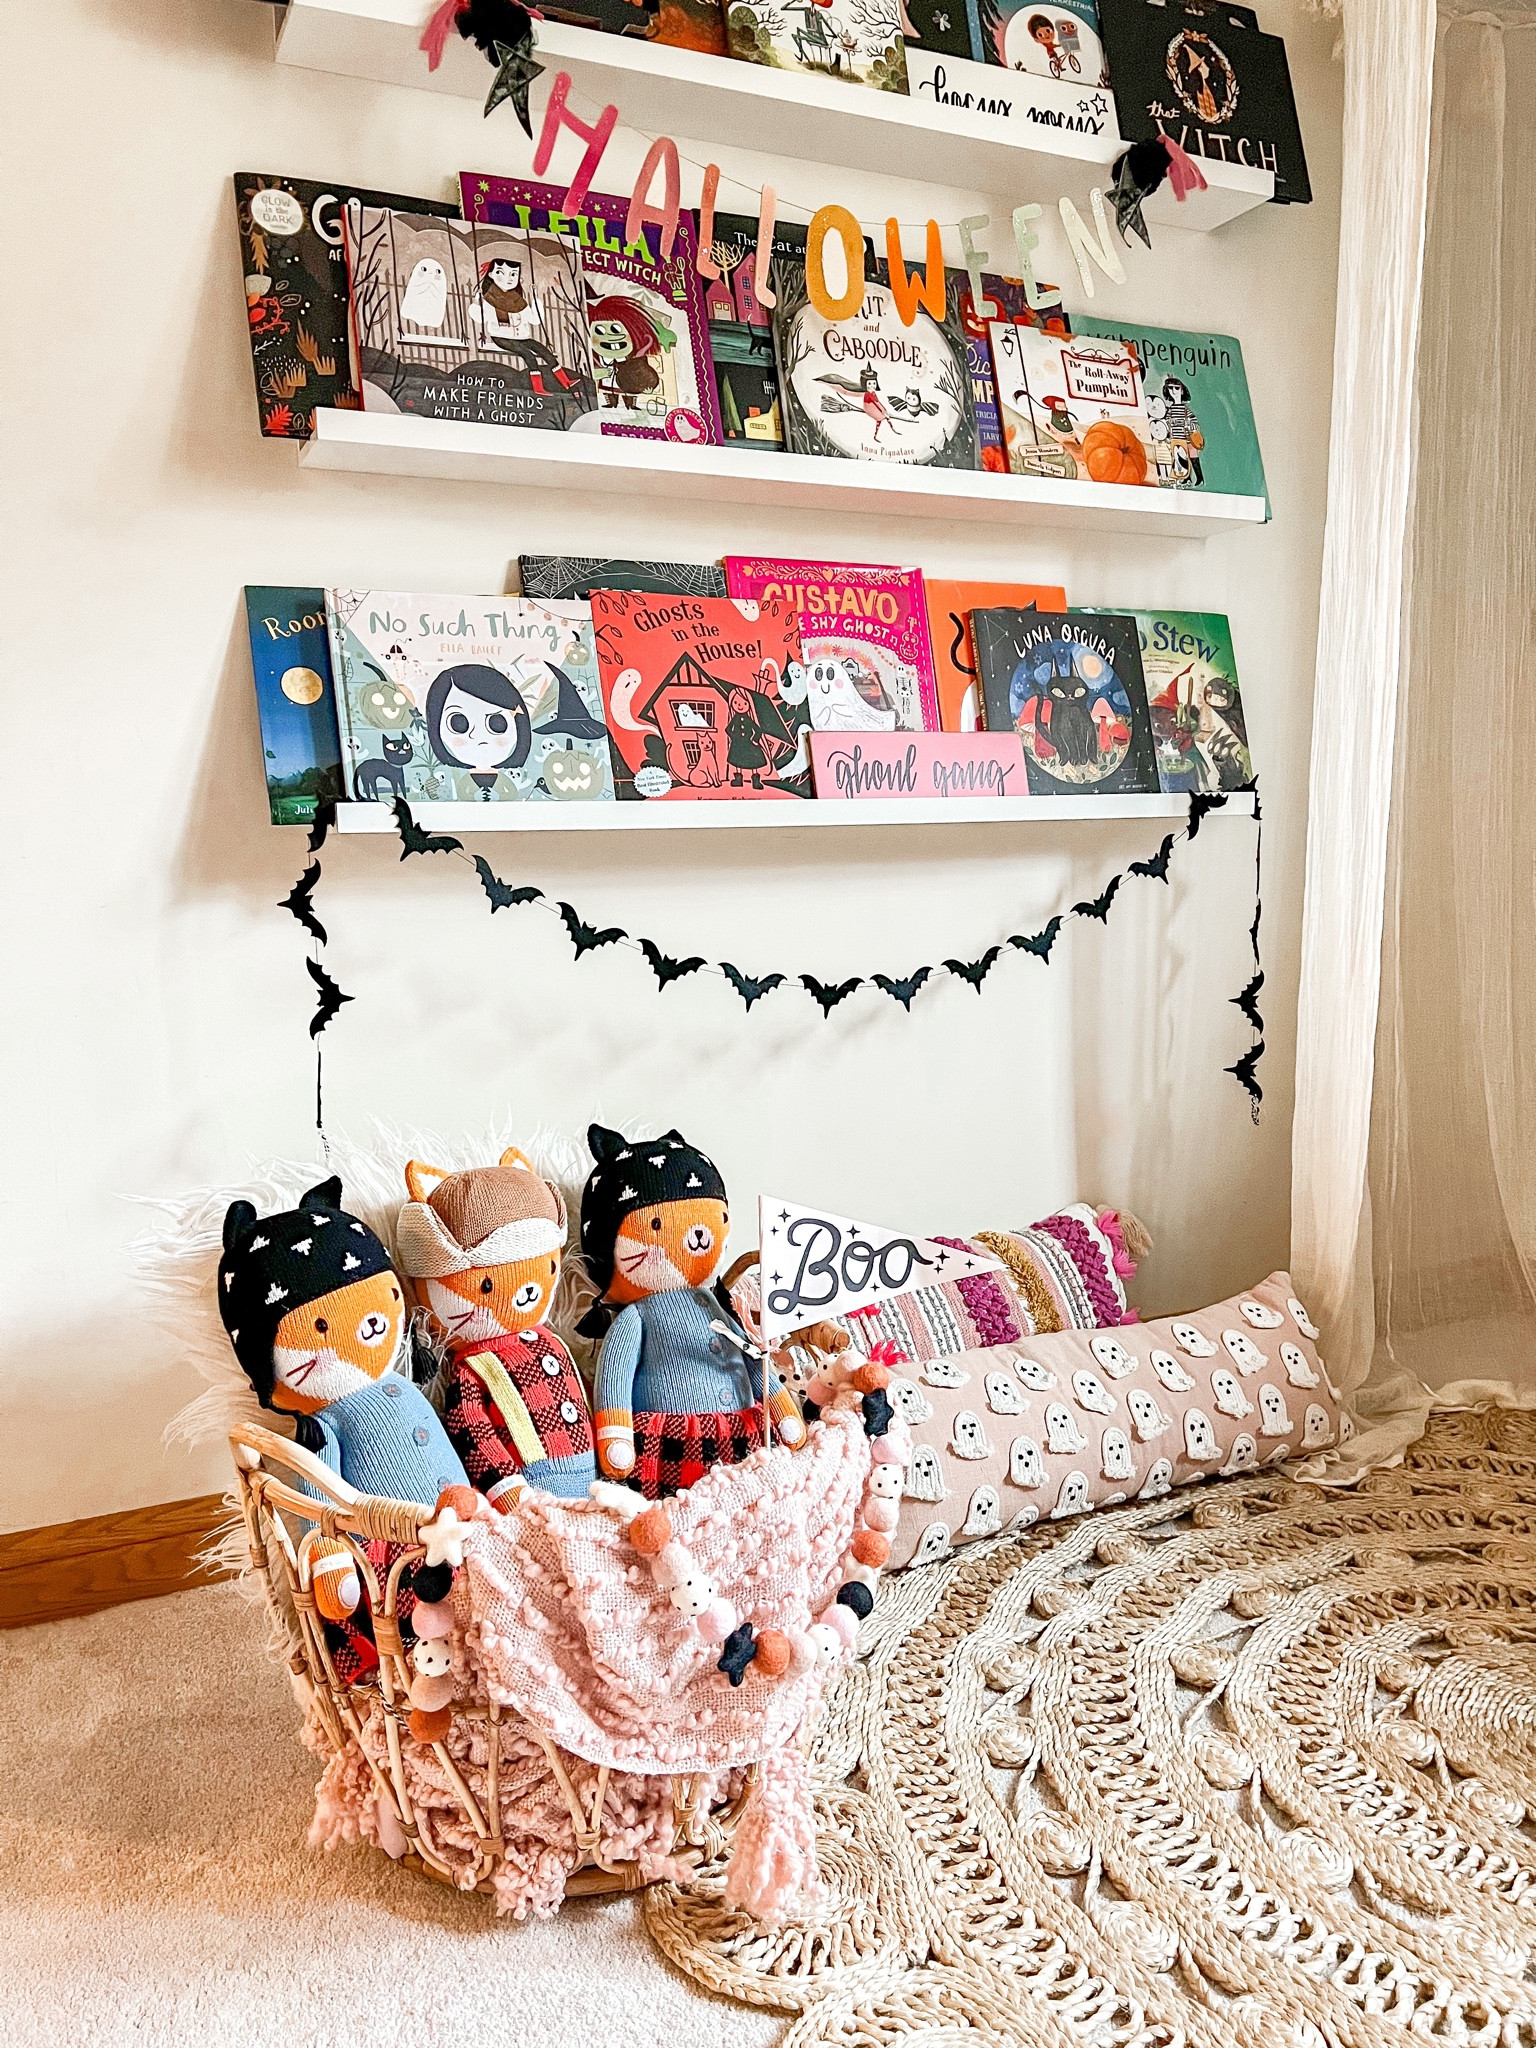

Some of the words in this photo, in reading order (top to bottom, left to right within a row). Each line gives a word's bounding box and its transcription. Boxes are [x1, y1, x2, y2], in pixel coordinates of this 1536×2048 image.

[1146, 100, 1181, 119] that
[261, 195, 291, 207] GLOW
[532, 70, 1127, 327] HALLOWEEN
[262, 213, 295, 225] DARK
[276, 206, 289, 214] the
[733, 231, 758, 248] The
[614, 256, 662, 286] WITCH
[863, 322, 880, 333] and
[822, 329, 922, 368] CABOODLE
[1087, 333, 1231, 377] penguin
[1067, 360, 1083, 369] The
[1084, 366, 1130, 385] Roll-Away
[457, 373, 485, 387] HOW
[487, 377, 505, 389] TO
[1074, 378, 1129, 399] Pumpkin
[423, 386, 470, 403] MAKE
[477, 391, 544, 410] FRIENDS
[434, 405, 470, 419] WITH
[477, 409, 485, 420] A
[490, 410, 536, 424] GHOST
[633, 599, 706, 633] Ghosts
[369, 610, 408, 634] No
[418, 609, 476, 638] Such
[483, 610, 562, 652] Thing
[670, 628, 690, 643] in
[691, 622, 720, 639] the
[810, 616, 839, 633] SHY
[842, 618, 892, 641] GHOST
[440, 643, 465, 654] ELLA
[693, 639, 763, 665] House!
[1013, 624, 1053, 659] LUNA
[1061, 623, 1116, 666] OSCURA
[1153, 621, 1221, 664] Stew
[827, 744, 918, 799] ghoul
[933, 760, 1015, 797] gang
[767, 1217, 934, 1315] Boo
